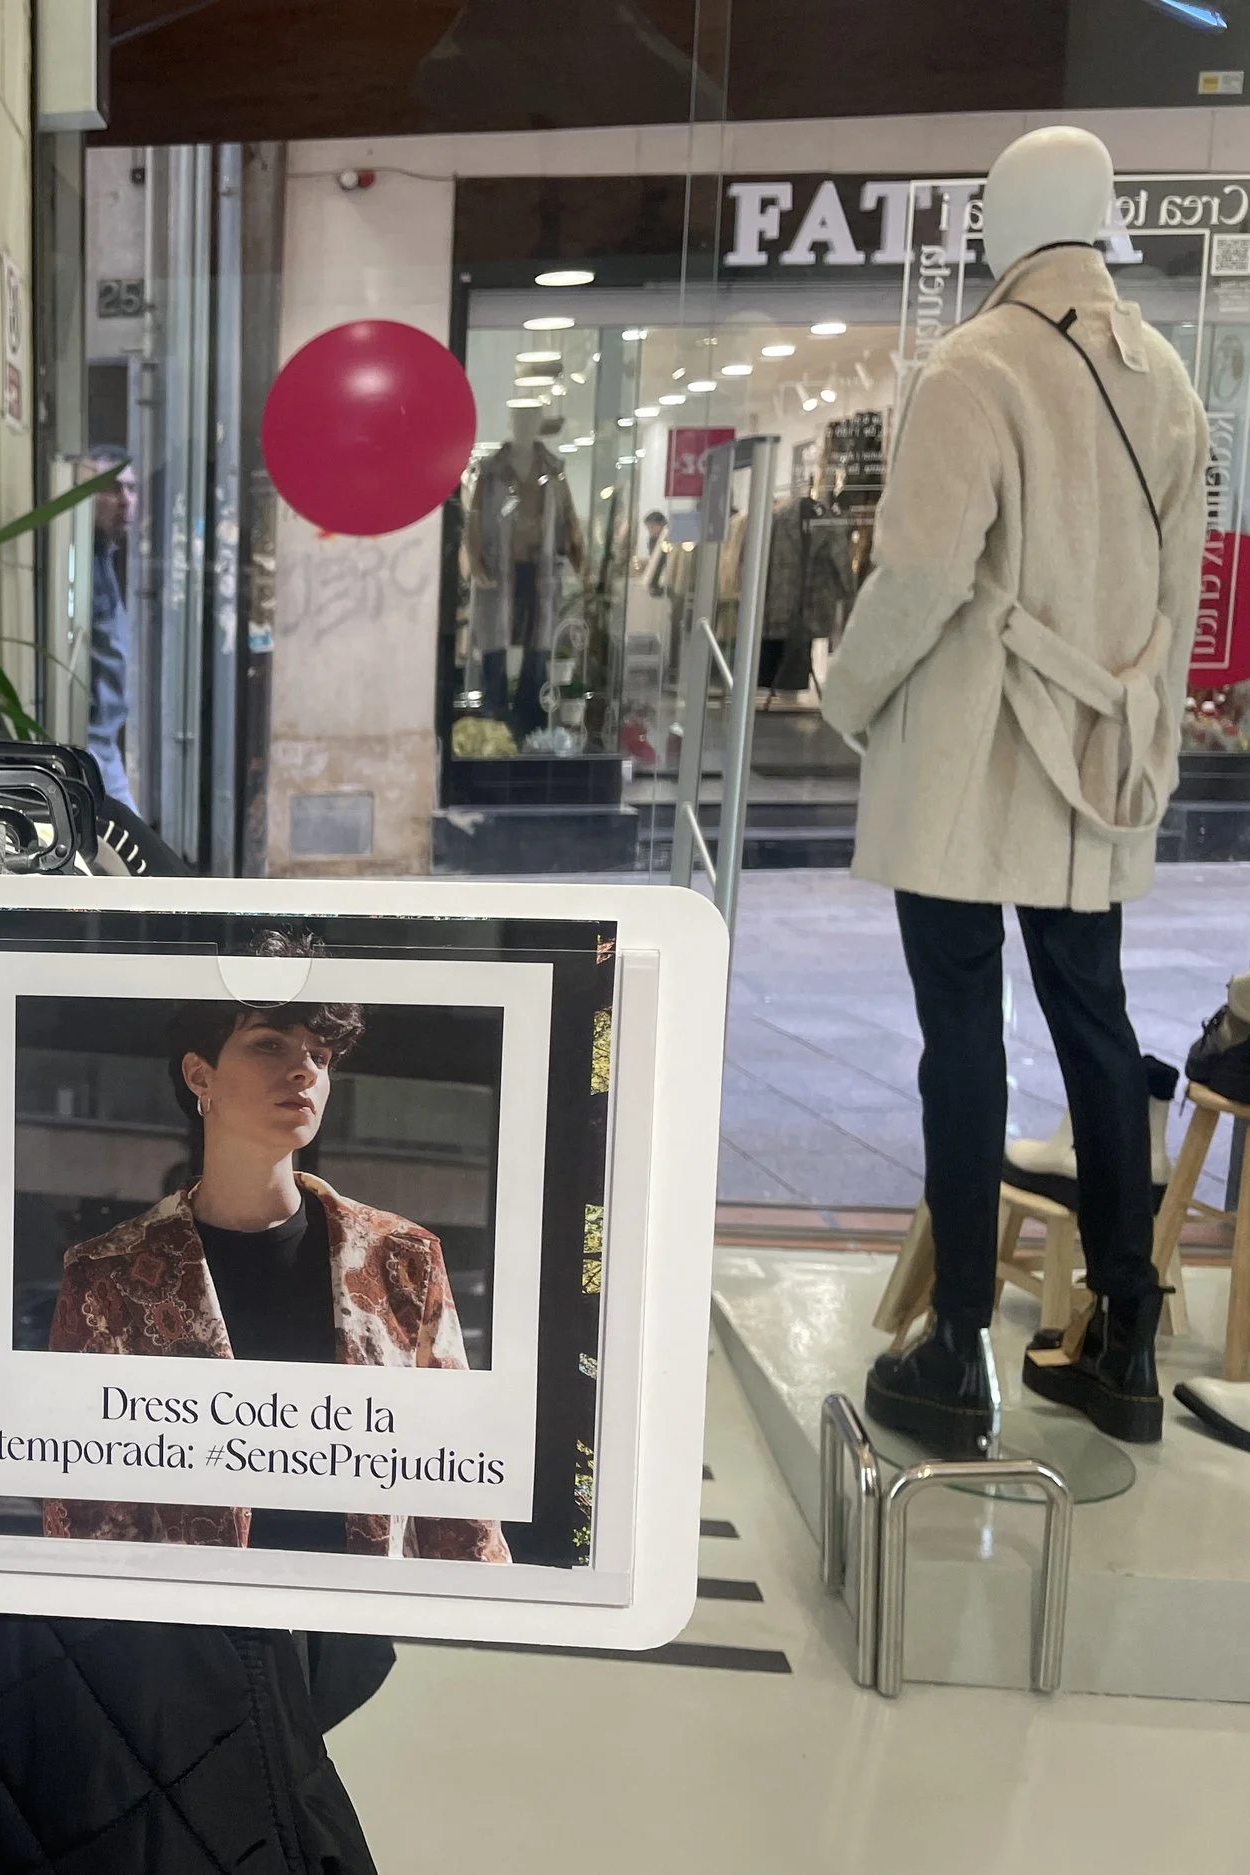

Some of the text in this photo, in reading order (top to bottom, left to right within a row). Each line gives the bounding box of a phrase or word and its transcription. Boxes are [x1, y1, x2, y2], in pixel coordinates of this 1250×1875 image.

[98, 281, 141, 315] 25
[101, 1386, 395, 1434] Dress Code de la
[204, 1437, 506, 1490] #SensePrejudicis
